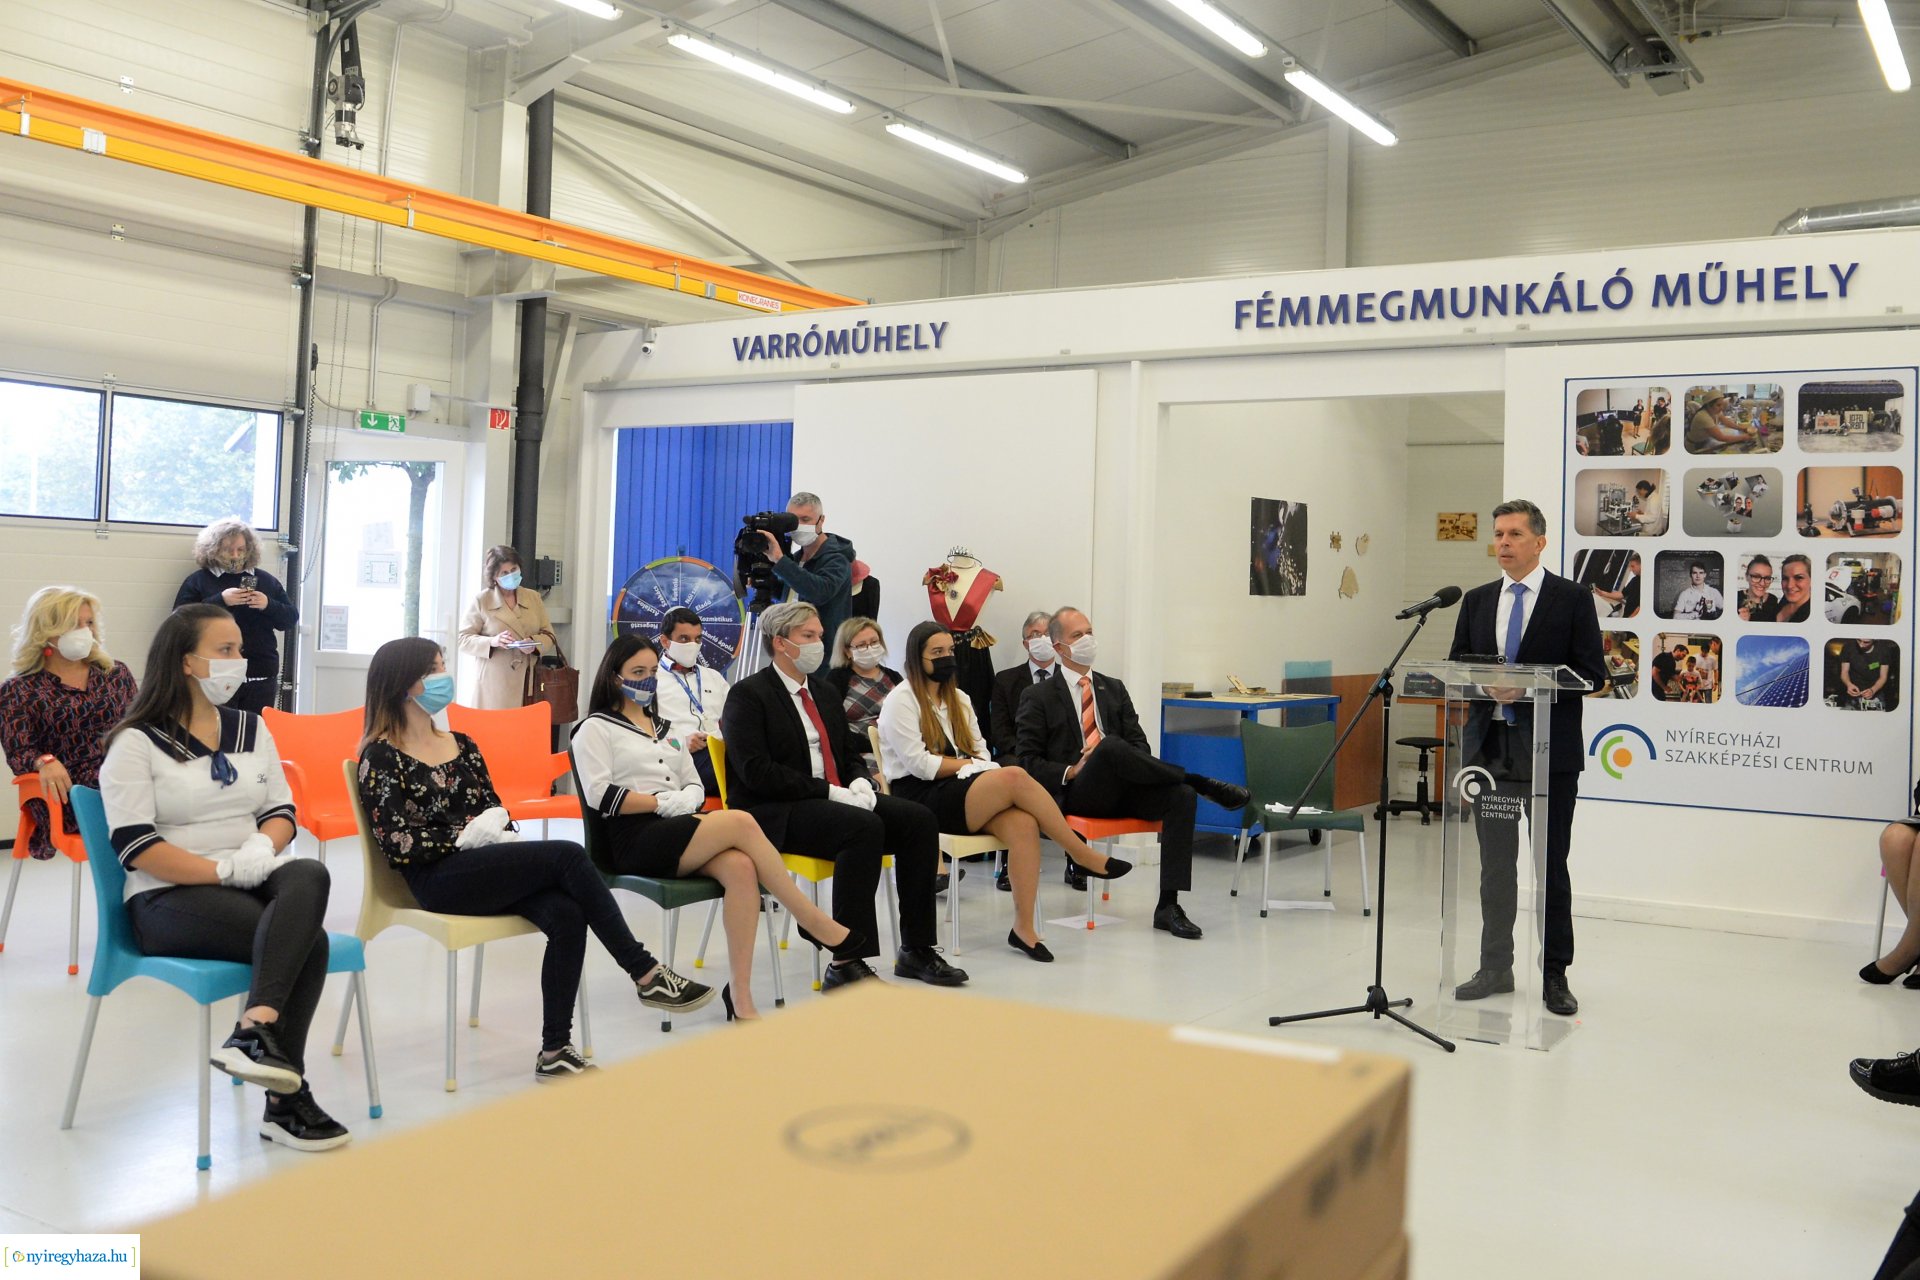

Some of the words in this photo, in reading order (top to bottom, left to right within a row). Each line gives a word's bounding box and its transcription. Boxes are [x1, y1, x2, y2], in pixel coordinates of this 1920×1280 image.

[737, 292, 780, 310] KONECRANES
[1234, 268, 1635, 330] FÉMMEGMUNKÁLÓ
[1651, 261, 1860, 309] MŰHELY
[732, 320, 949, 362] VARRÓMŰHELY
[1665, 728, 1781, 749] NYÍREGYHÁZI
[1664, 749, 1778, 770] SZAKKÉPZÉSI
[1783, 757, 1874, 776] CENTRUM
[1481, 811, 1515, 819] CENTRUM
